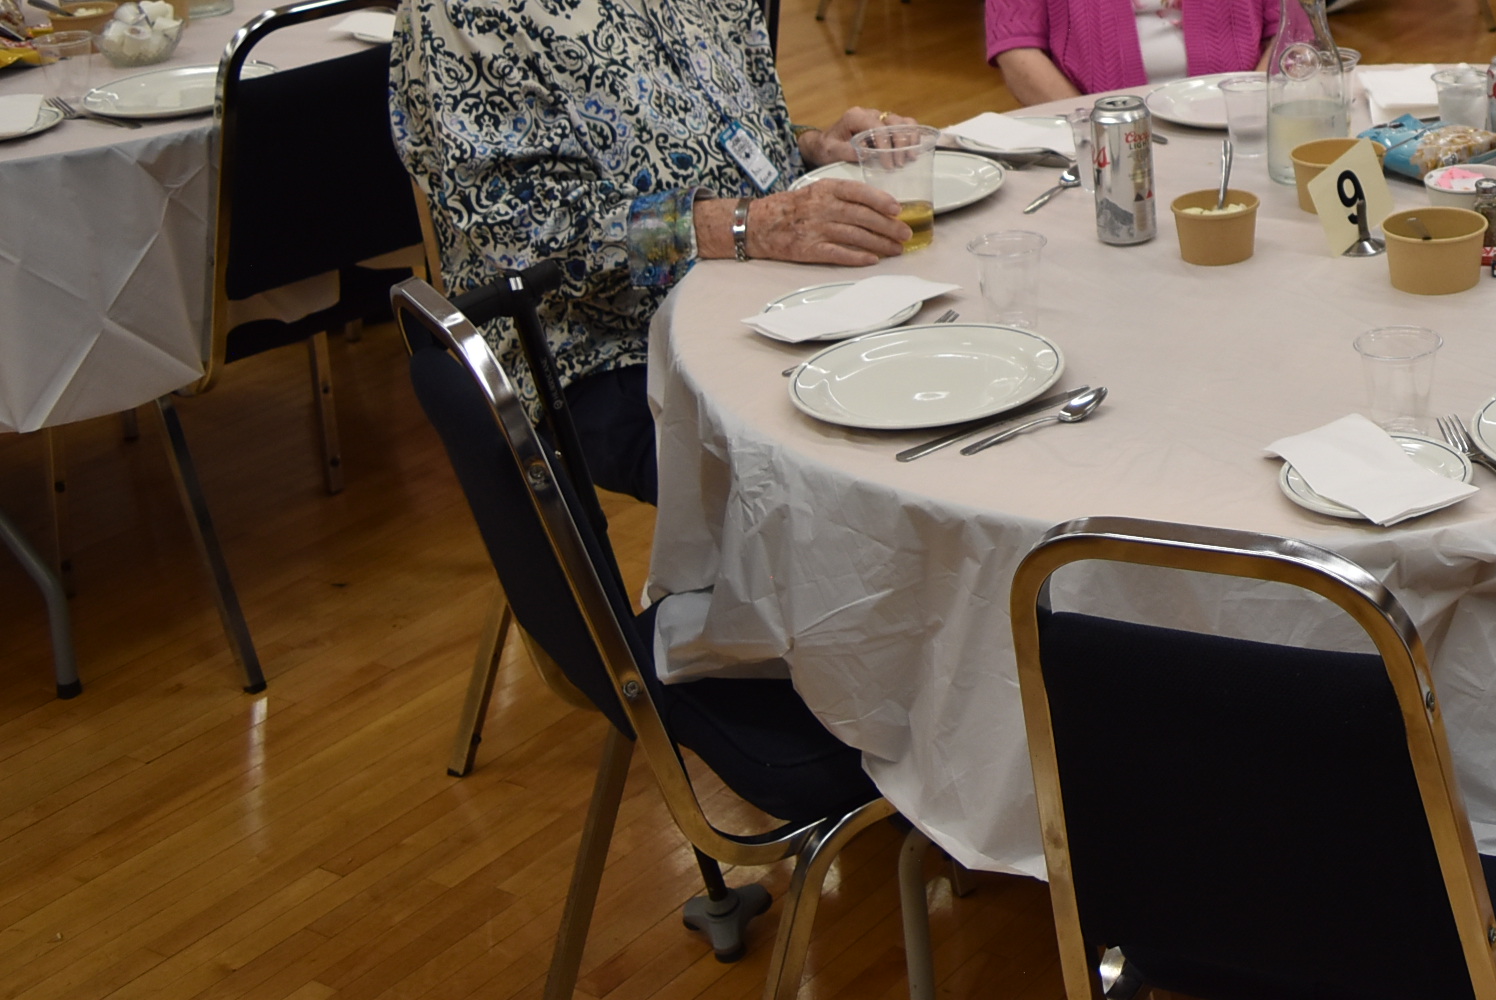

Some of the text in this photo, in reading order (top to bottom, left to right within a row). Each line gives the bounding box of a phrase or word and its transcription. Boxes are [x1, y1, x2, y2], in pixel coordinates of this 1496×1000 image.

[1125, 131, 1150, 144] Coo
[1129, 140, 1150, 151] LIGH
[1336, 169, 1366, 225] 9
